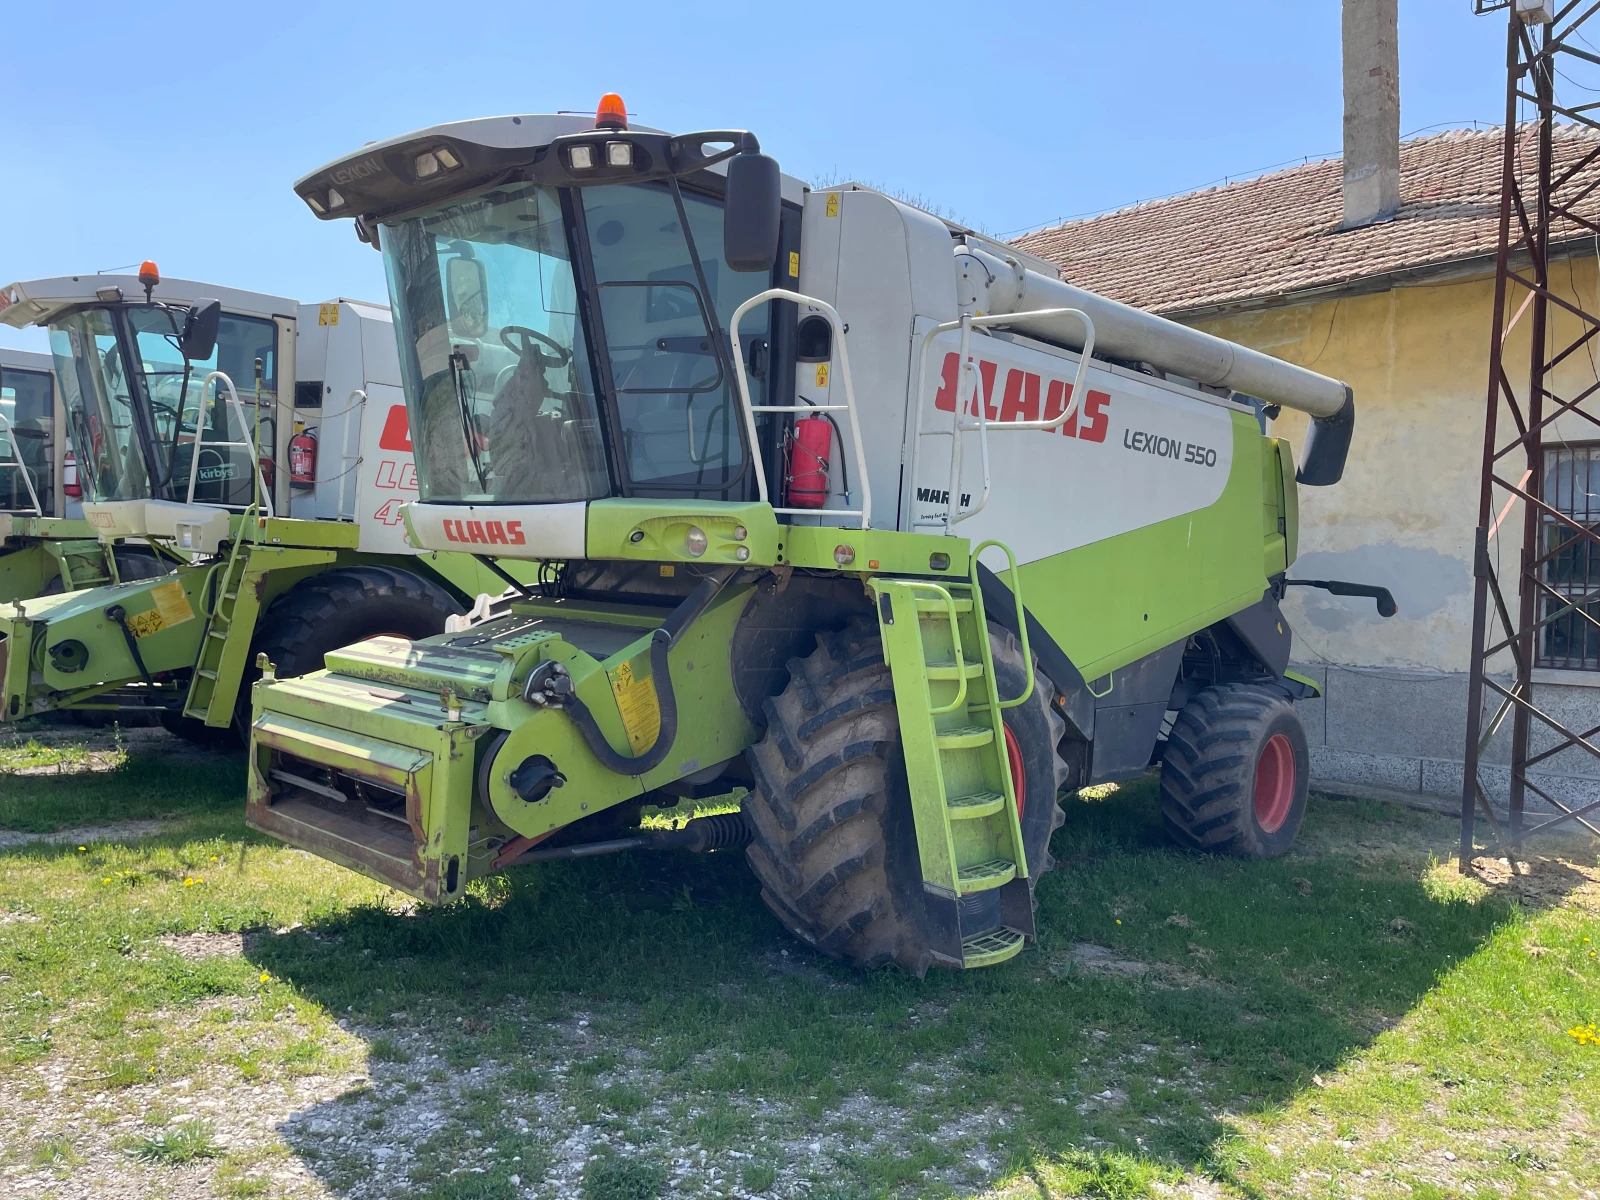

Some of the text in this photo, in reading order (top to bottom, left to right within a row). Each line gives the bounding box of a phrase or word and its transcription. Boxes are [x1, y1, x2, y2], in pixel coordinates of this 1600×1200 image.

[330, 158, 382, 185] LEXION
[935, 352, 1111, 443] CLAAS
[1123, 428, 1217, 467] LEXION 550
[200, 468, 234, 479] kirbys
[916, 487, 971, 507] MARH
[442, 519, 526, 545] CLAAS
